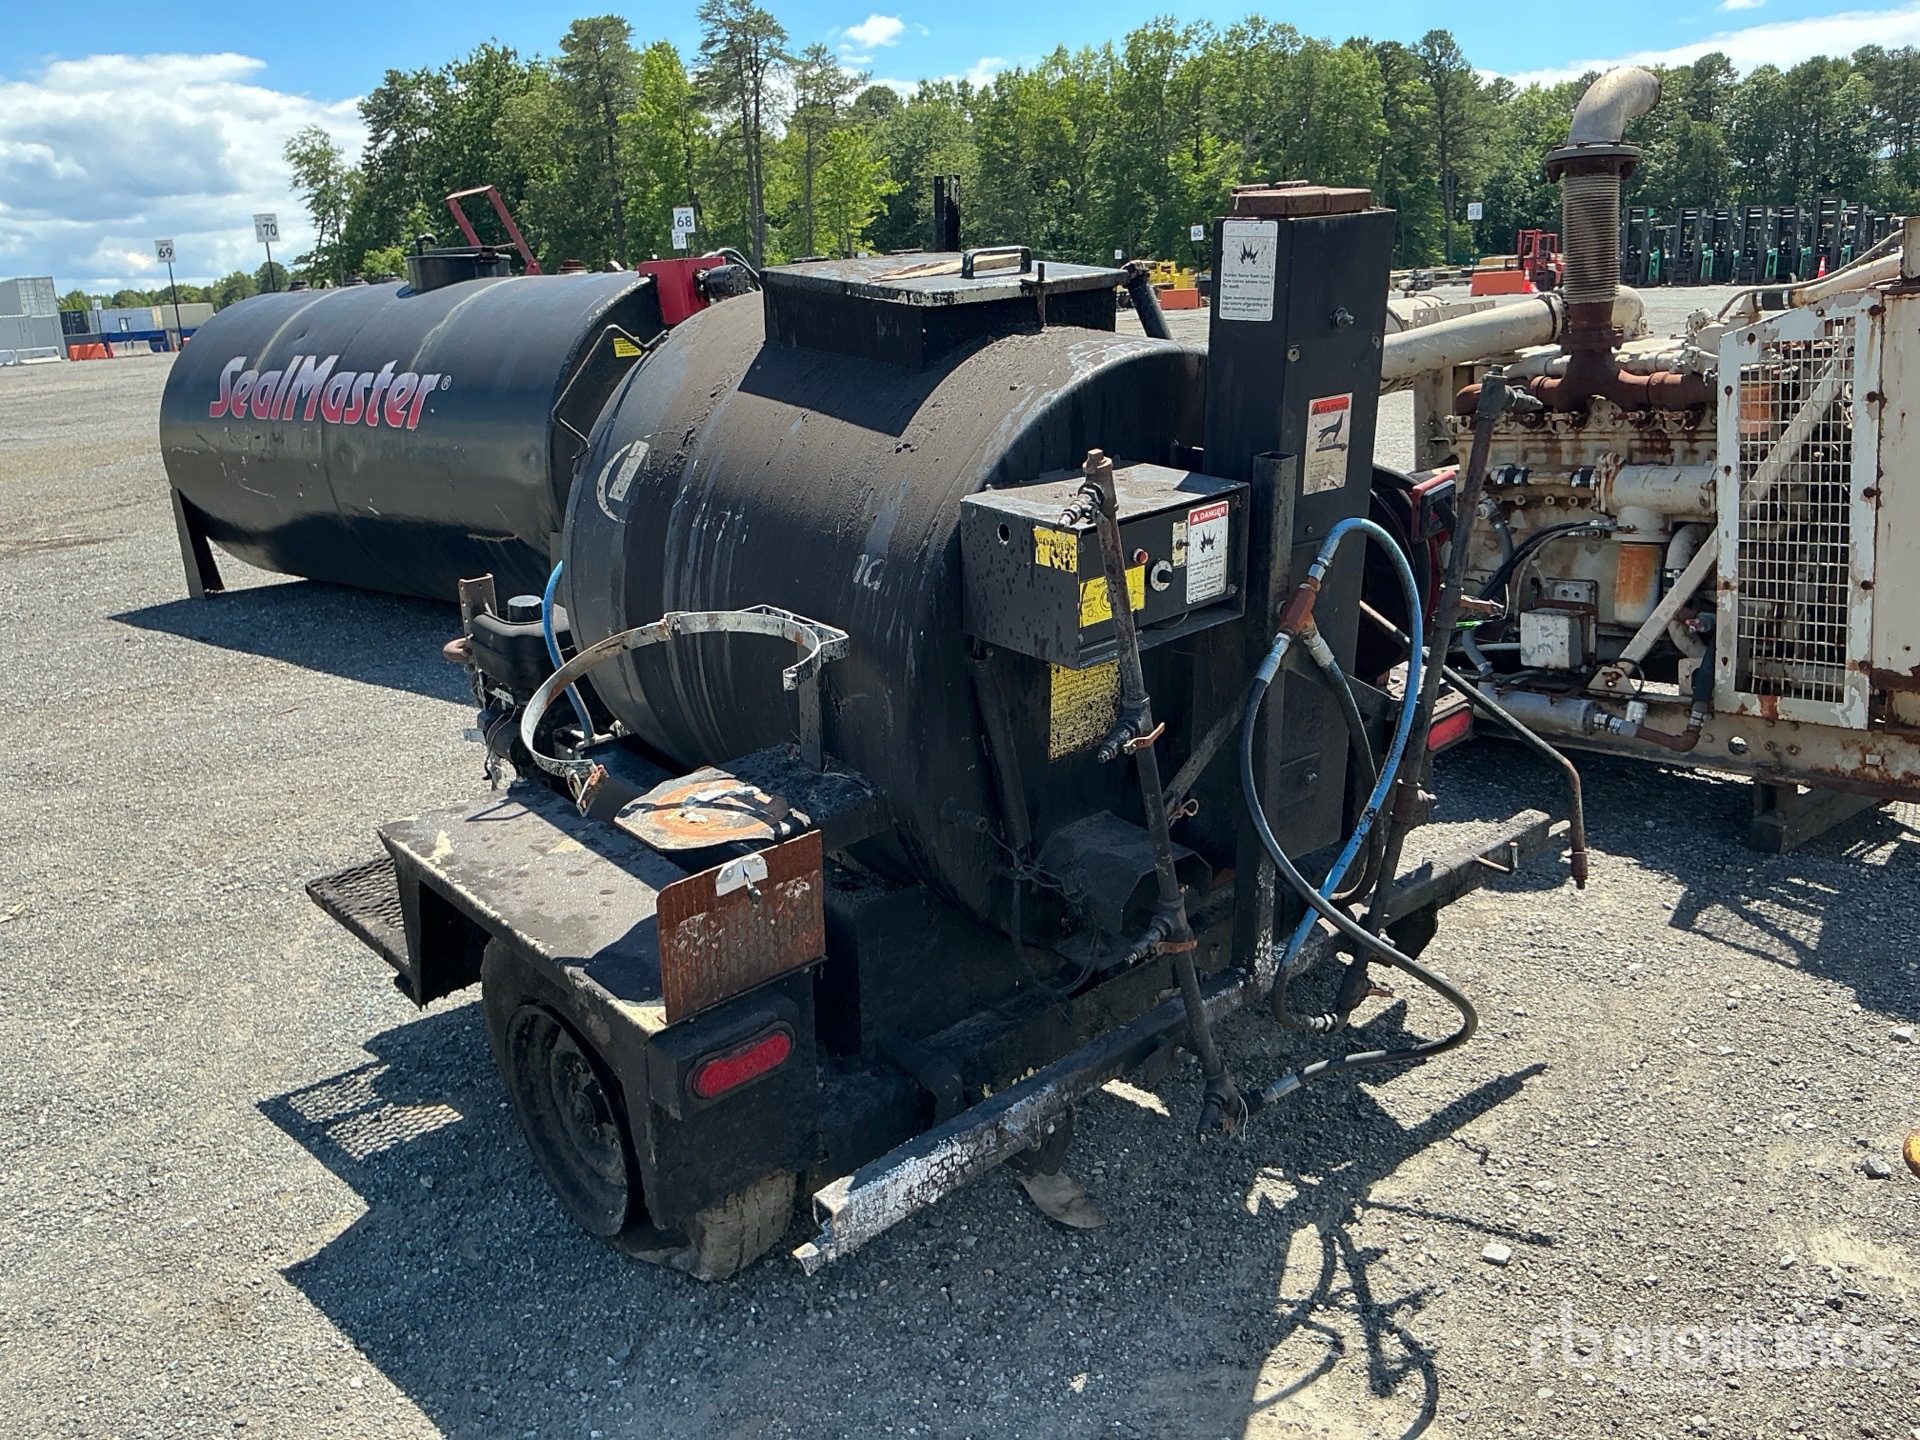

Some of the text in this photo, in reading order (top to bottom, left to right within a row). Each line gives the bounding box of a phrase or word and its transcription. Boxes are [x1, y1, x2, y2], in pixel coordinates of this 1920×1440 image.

[677, 215, 693, 228] 68
[262, 223, 277, 236] 70
[158, 247, 173, 258] 69
[1199, 506, 1225, 520] DANGER
